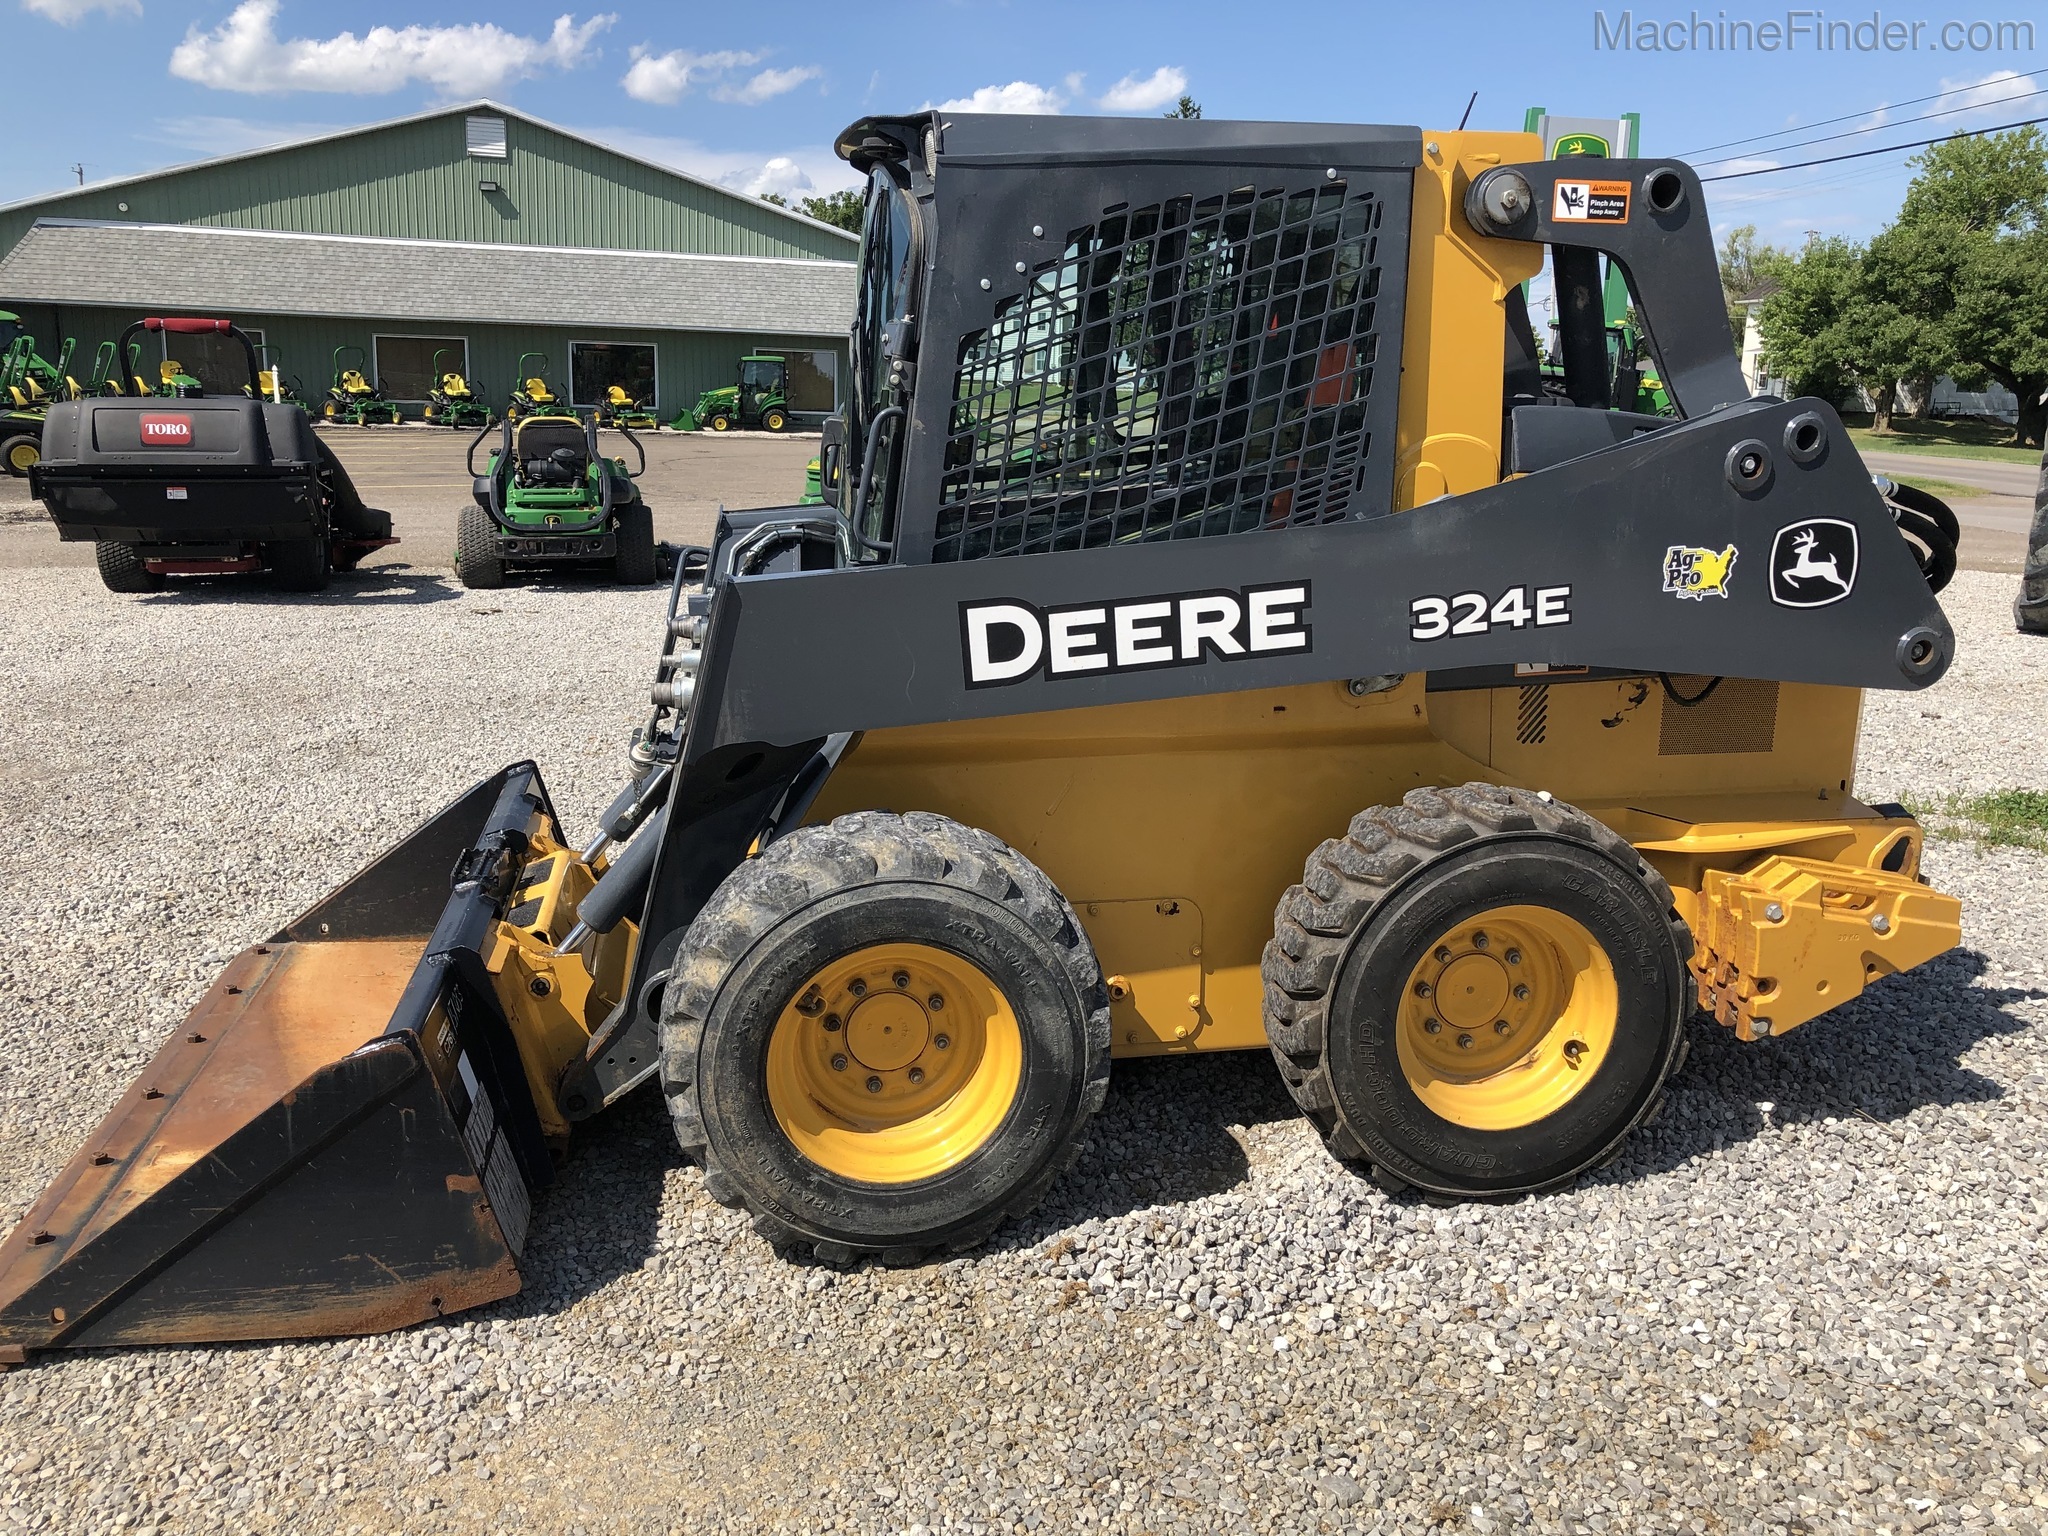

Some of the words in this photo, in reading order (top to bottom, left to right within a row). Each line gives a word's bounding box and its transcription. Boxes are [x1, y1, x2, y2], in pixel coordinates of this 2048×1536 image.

[1590, 199, 1608, 207] Pinch
[145, 424, 188, 435] TORO
[1666, 568, 1702, 589] Pro
[1667, 549, 1702, 572] Ag-
[1411, 586, 1571, 640] 324E
[1679, 587, 1719, 598] AgProCo.com
[966, 586, 1307, 683] DEERE
[981, 900, 1047, 953] SOLIDEAL
[1561, 872, 1659, 987] CARLISLE
[1597, 858, 1649, 910] PREMIUM
[1647, 910, 1670, 949] DUTY
[944, 918, 1041, 995] XTRA-WALL
[734, 940, 819, 1039] XTRA-WALL
[1341, 1091, 1367, 1129] DUTY
[971, 1102, 1052, 1194] XTRA-WALL
[1364, 1128, 1421, 1176] PREMIUM
[1402, 1126, 1497, 1171] GUARD
[756, 1150, 854, 1220] XTRA-WALL
